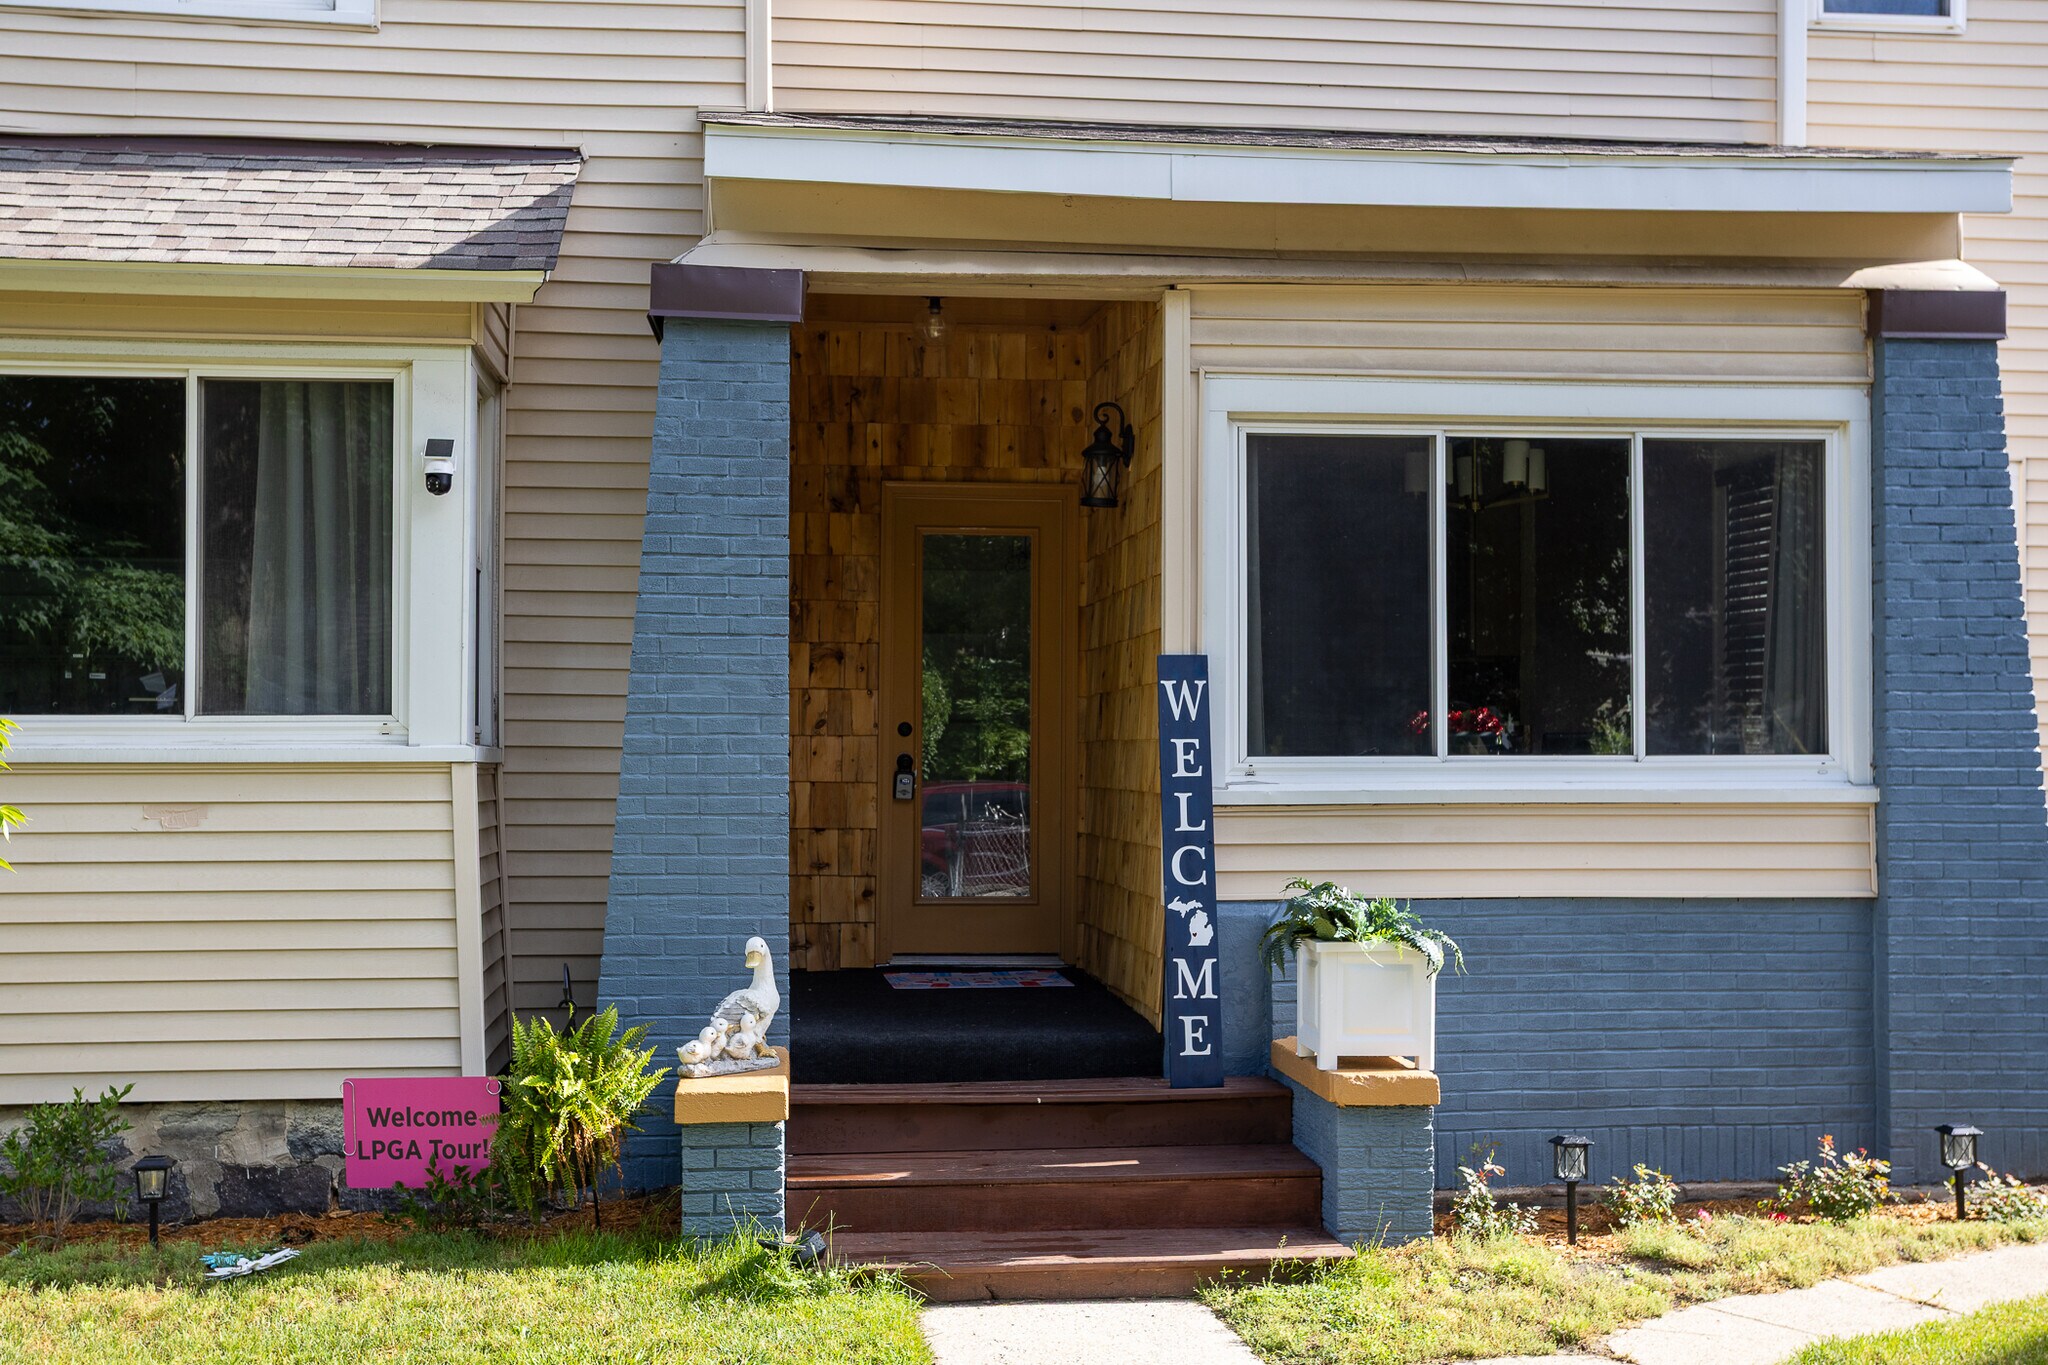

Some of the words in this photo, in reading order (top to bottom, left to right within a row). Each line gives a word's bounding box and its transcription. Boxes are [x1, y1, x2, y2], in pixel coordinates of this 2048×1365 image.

[1160, 680, 1218, 1057] WELCME
[367, 1106, 477, 1127] Welcome
[358, 1140, 422, 1160] LPGA
[429, 1139, 489, 1159] Tour!
